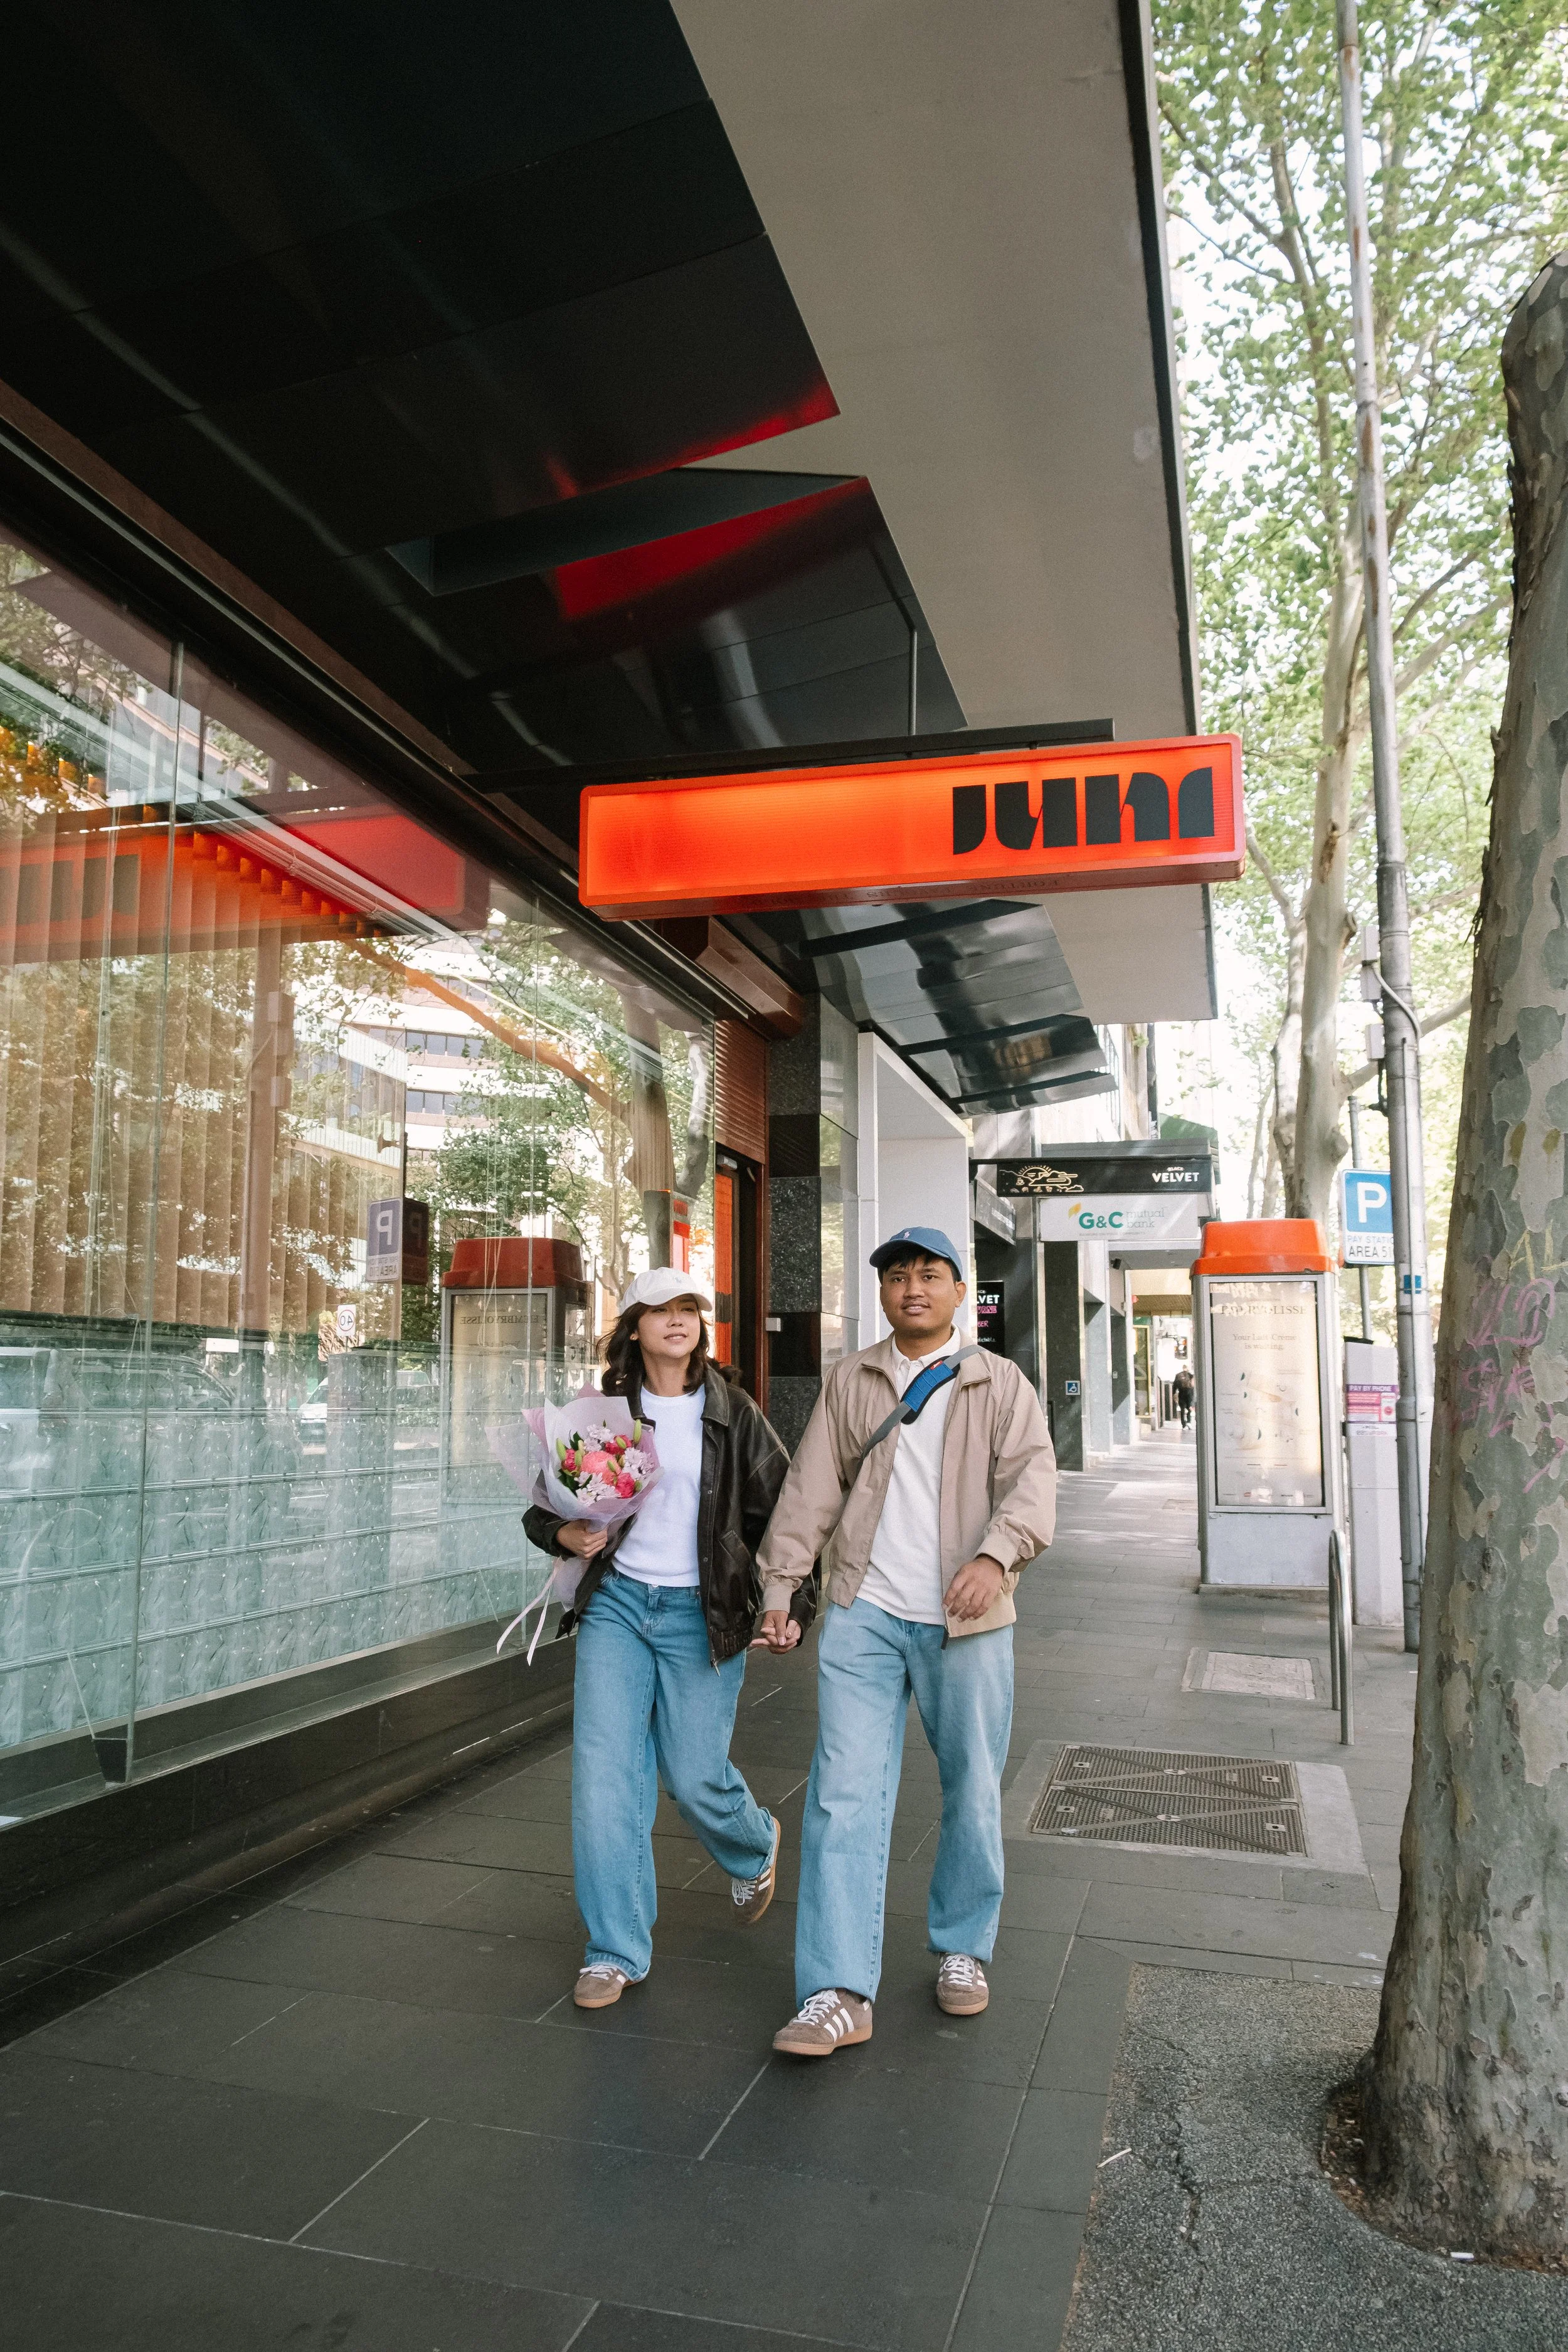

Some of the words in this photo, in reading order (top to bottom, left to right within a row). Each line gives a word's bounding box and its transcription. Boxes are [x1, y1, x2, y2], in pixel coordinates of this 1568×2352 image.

[1152, 1172, 1199, 1183] VELVET
[1357, 1182, 1387, 1223] P
[1126, 1207, 1164, 1217] mutual
[1078, 1211, 1124, 1229] G&C
[1126, 1218, 1155, 1228] bank
[1347, 1235, 1362, 1243] PAY
[1349, 1246, 1379, 1258] AREA
